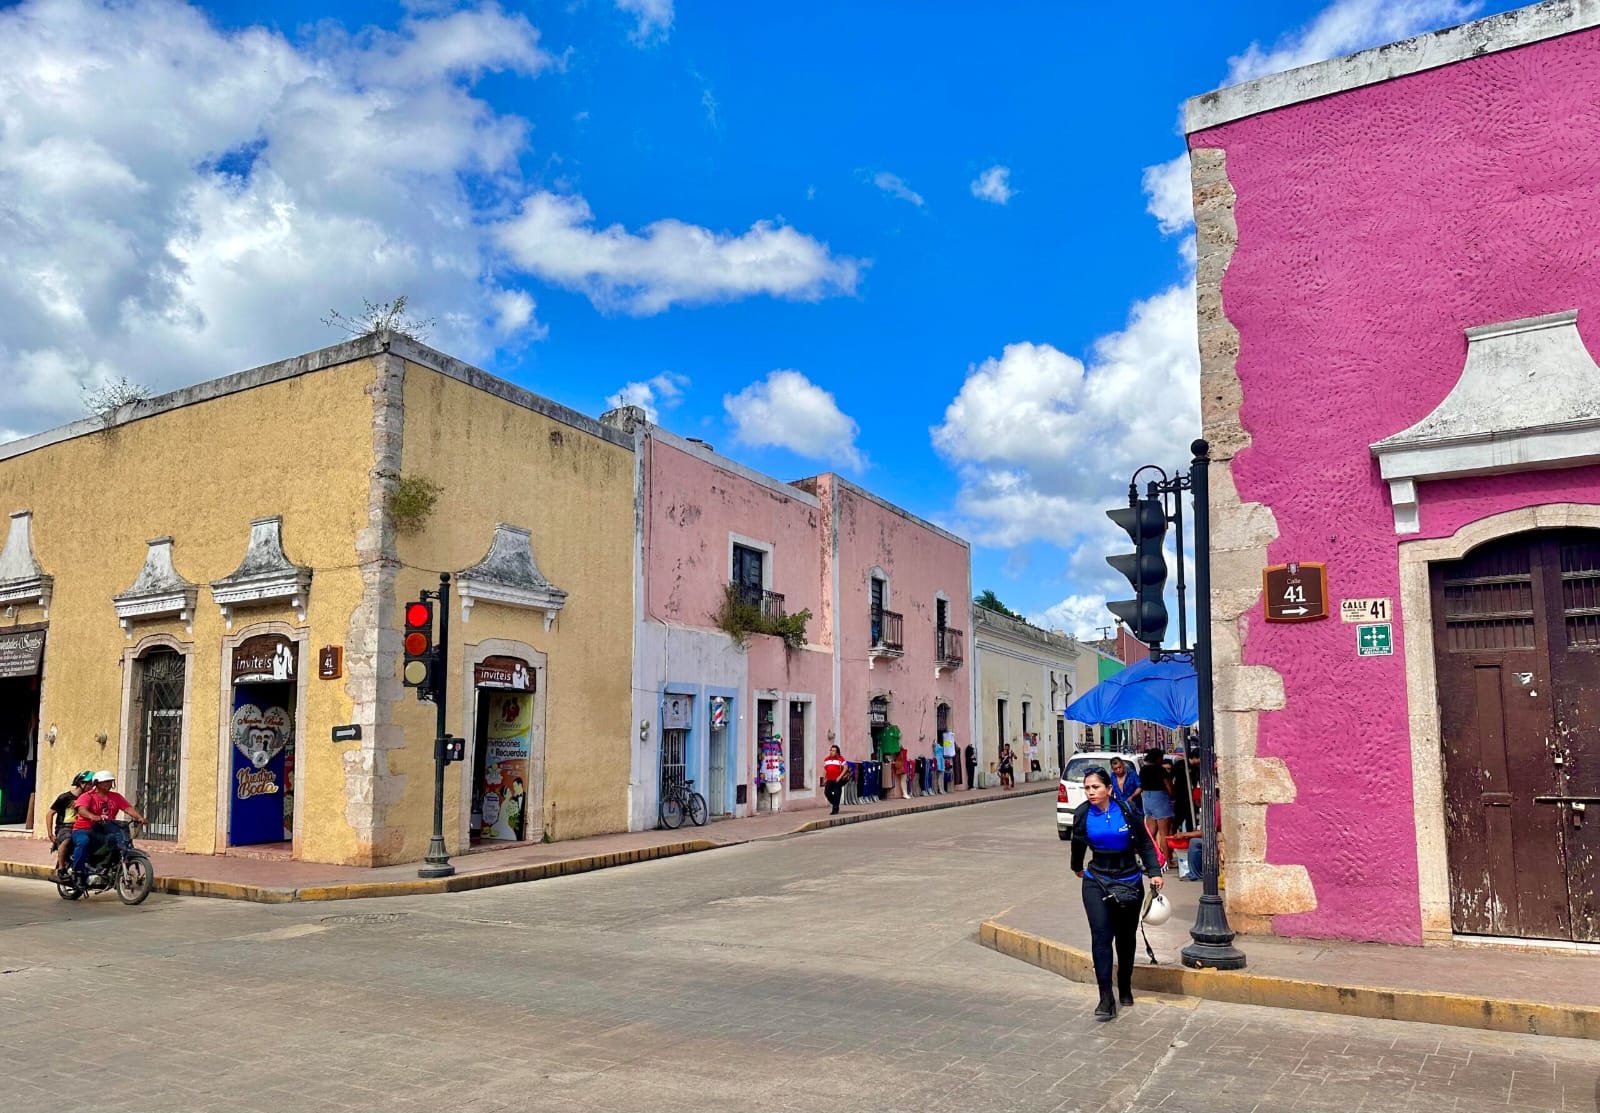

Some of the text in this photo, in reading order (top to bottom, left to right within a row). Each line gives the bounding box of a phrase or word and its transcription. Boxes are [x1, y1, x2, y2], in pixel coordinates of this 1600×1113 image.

[1283, 585, 1306, 603] 41
[1342, 600, 1368, 609] CALLE
[1370, 600, 1386, 619] 41
[236, 655, 272, 670] inviteis
[324, 658, 333, 669] 41
[481, 668, 512, 681] inviteis
[495, 748, 527, 758] Recuerdos
[236, 766, 276, 784] Nuestra
[237, 781, 280, 799] Boda
